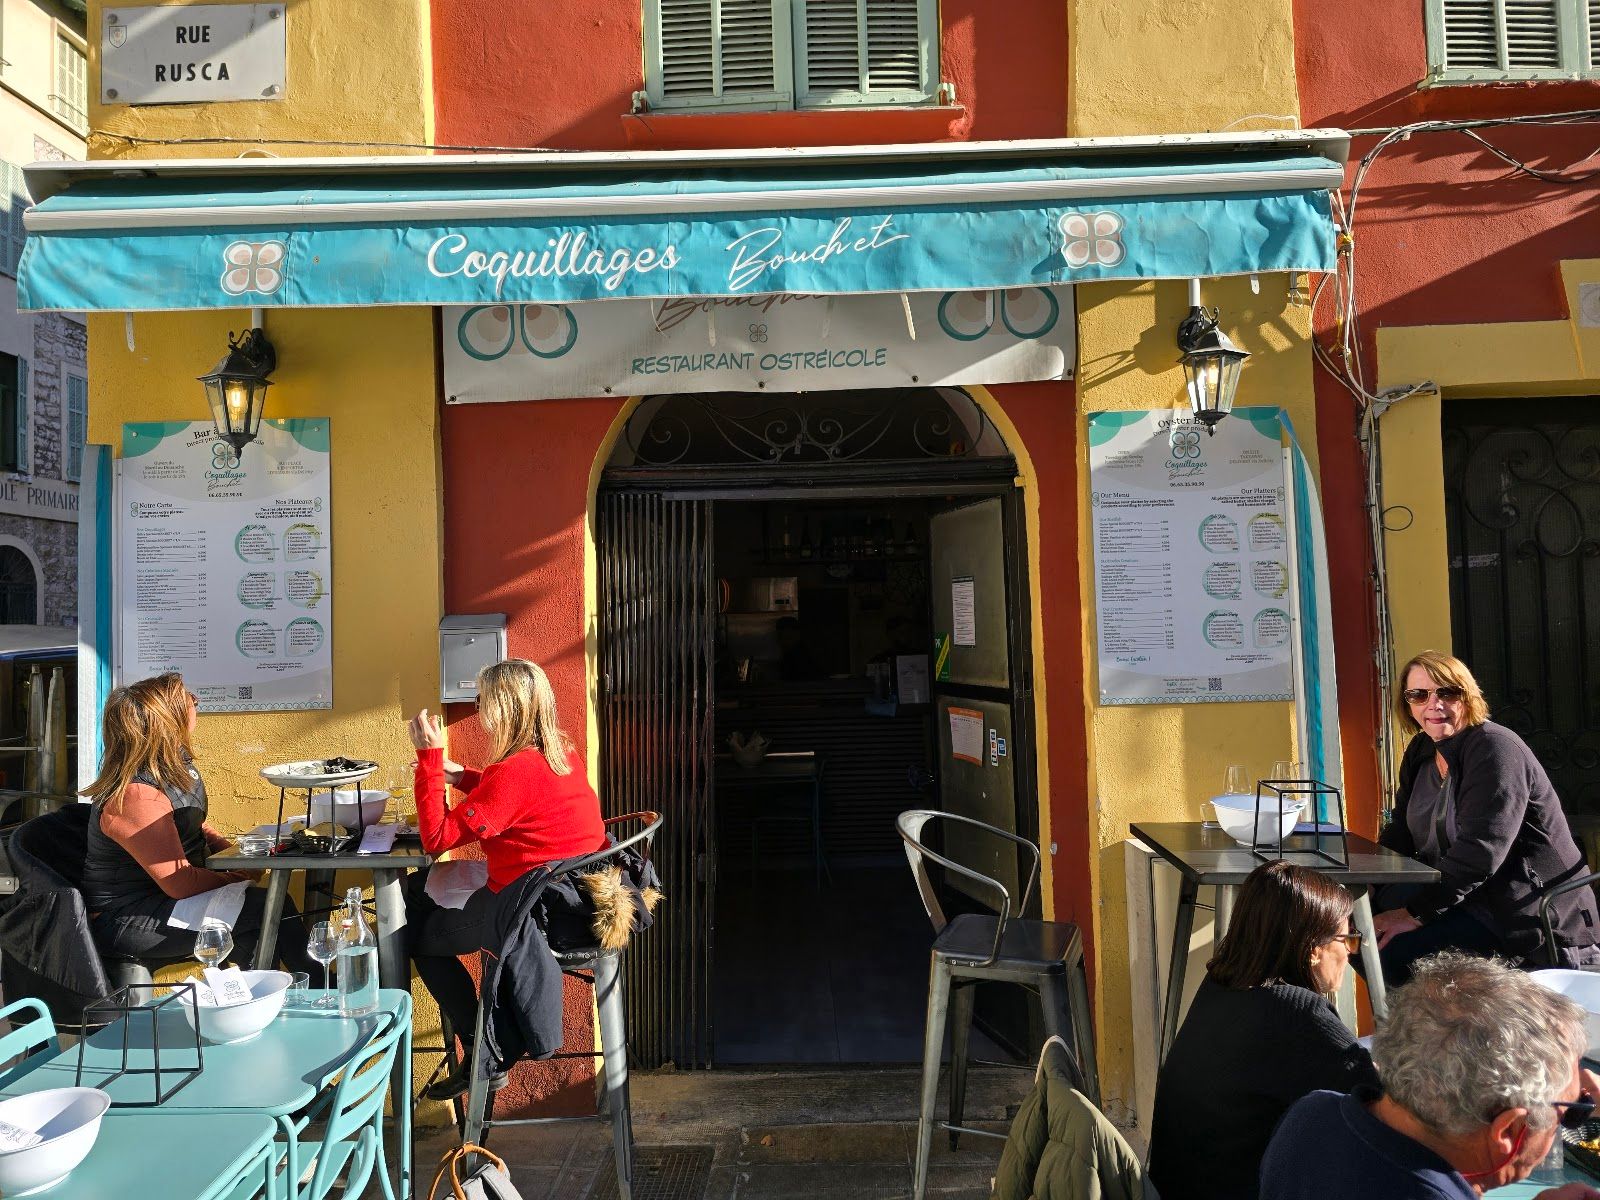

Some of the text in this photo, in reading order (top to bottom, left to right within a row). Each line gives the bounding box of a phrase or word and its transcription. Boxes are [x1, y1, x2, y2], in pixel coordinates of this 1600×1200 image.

[176, 25, 210, 44] RUE
[155, 62, 230, 82] RUSCA
[427, 213, 910, 298] Coquillages Bouchet
[632, 347, 887, 375] RESTAURANT OSTRÉICOLE
[1158, 417, 1206, 428] Oyster Ba
[193, 430, 211, 439] Bar
[1165, 460, 1207, 470] Coquillages
[204, 470, 246, 480] Coquillages
